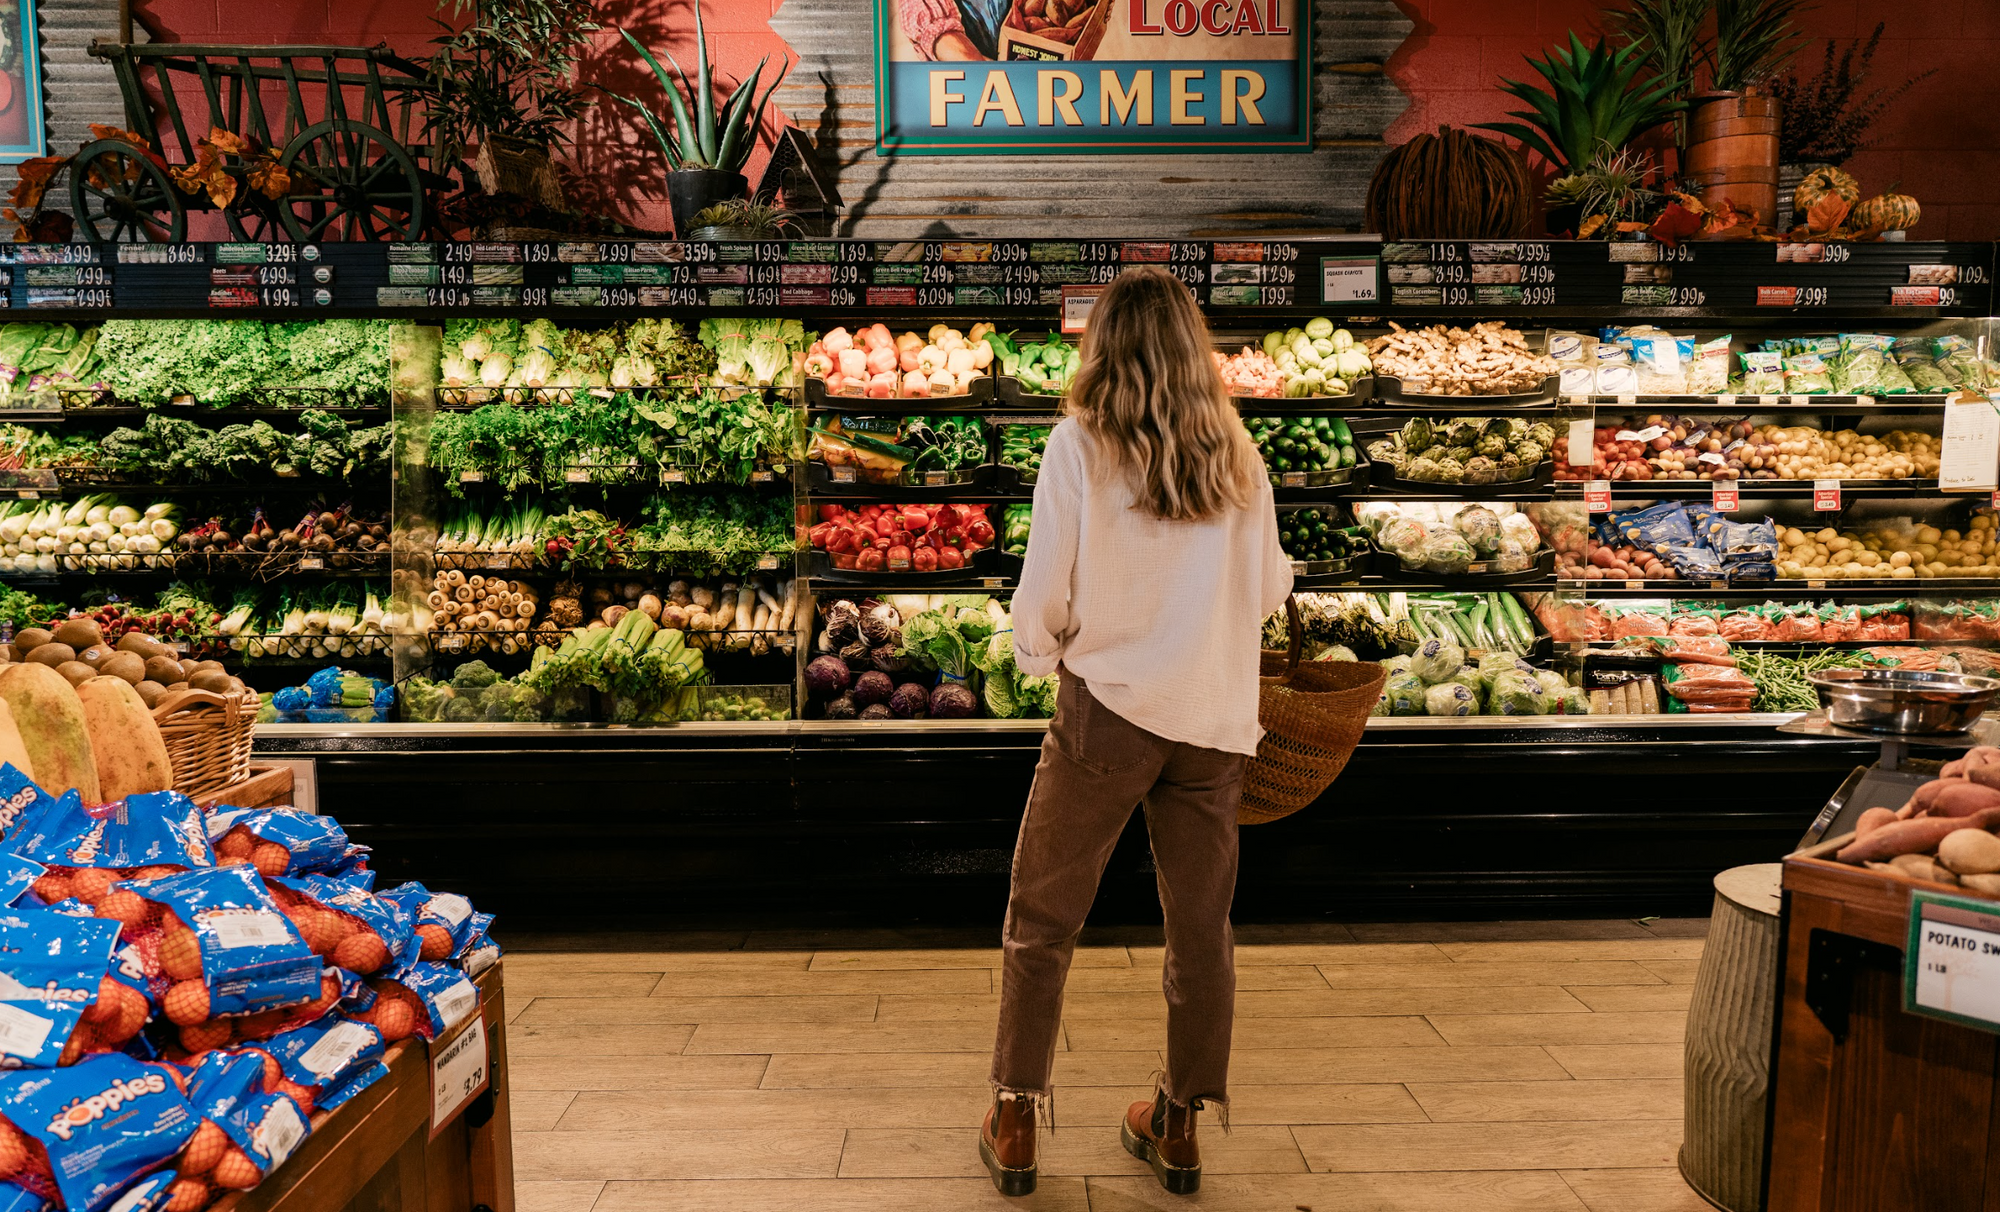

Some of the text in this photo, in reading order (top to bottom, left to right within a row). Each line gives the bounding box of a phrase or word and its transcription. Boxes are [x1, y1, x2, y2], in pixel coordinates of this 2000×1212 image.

[1129, 0, 1290, 36] LOCAL
[1012, 44, 1038, 59] HONEST
[928, 69, 1267, 128] FARMER
[685, 243, 708, 262] 3.59
[923, 265, 946, 283] 2.49
[1928, 931, 1977, 951] POTATO
[1936, 964, 1947, 973] LB
[437, 1044, 460, 1071] MANDARIN
[468, 1028, 476, 1043] BAG
[46, 1074, 166, 1140] Poppies
